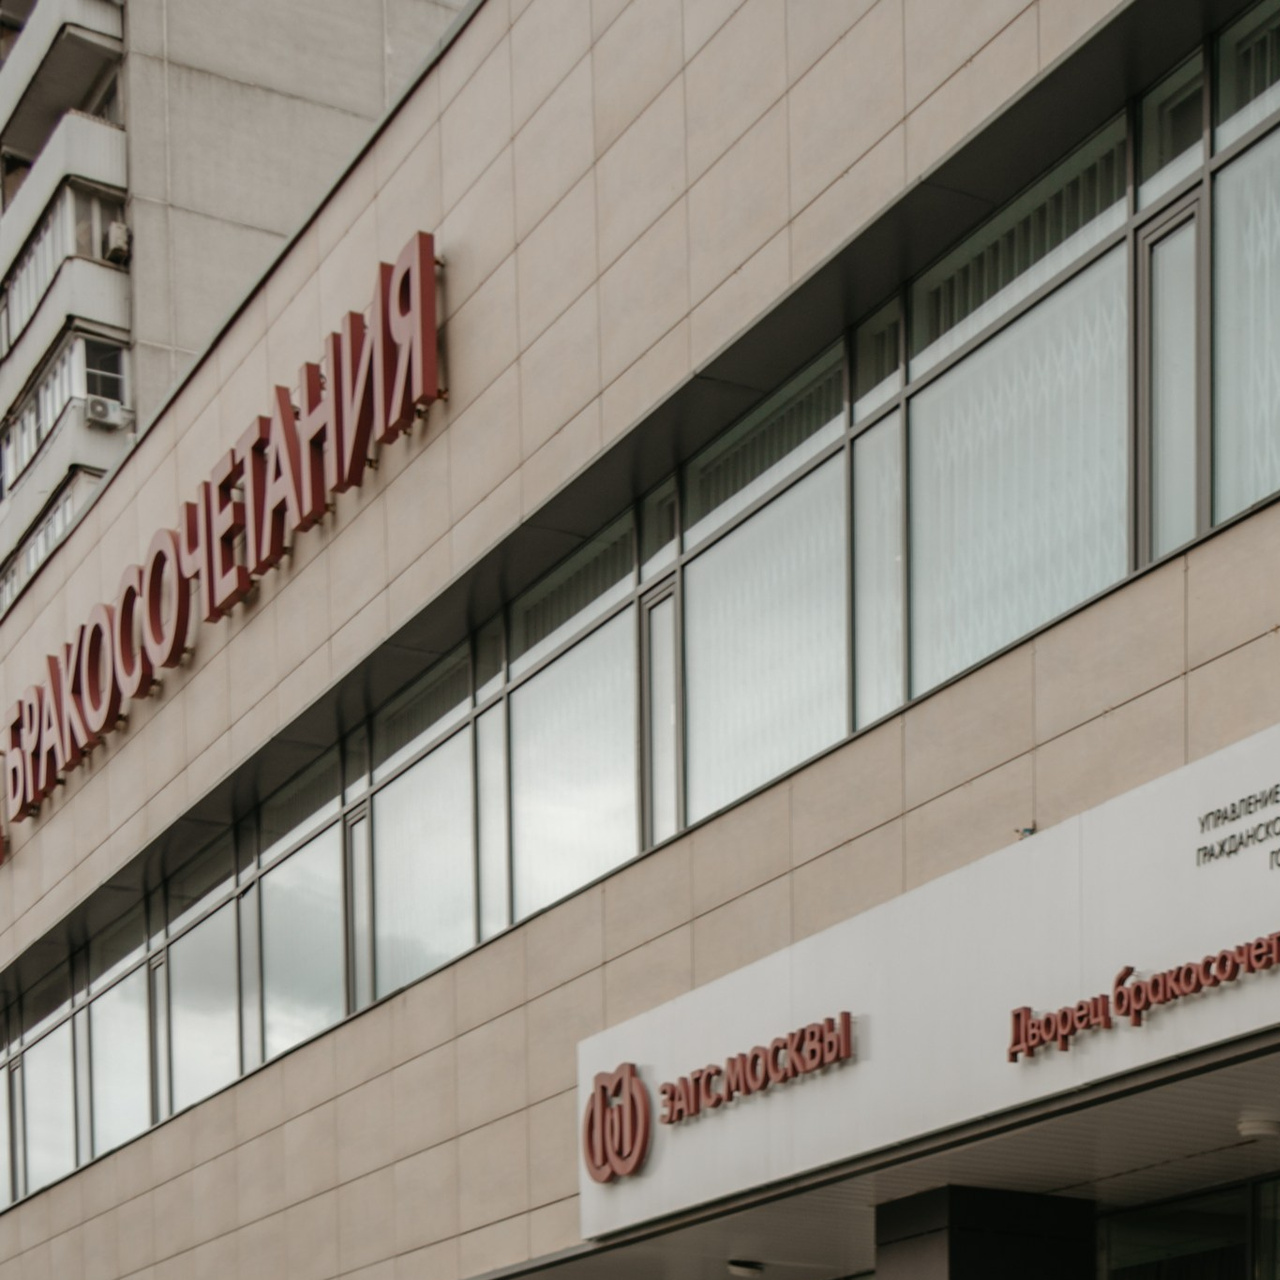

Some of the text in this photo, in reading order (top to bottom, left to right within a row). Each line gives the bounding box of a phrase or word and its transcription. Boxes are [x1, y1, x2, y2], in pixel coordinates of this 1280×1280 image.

[3, 231, 434, 823] БРАКОСОЧЕТАНИЯ
[1198, 784, 1280, 833] УПРАВЛЕНИЕ
[1008, 994, 1112, 1062] Дворец
